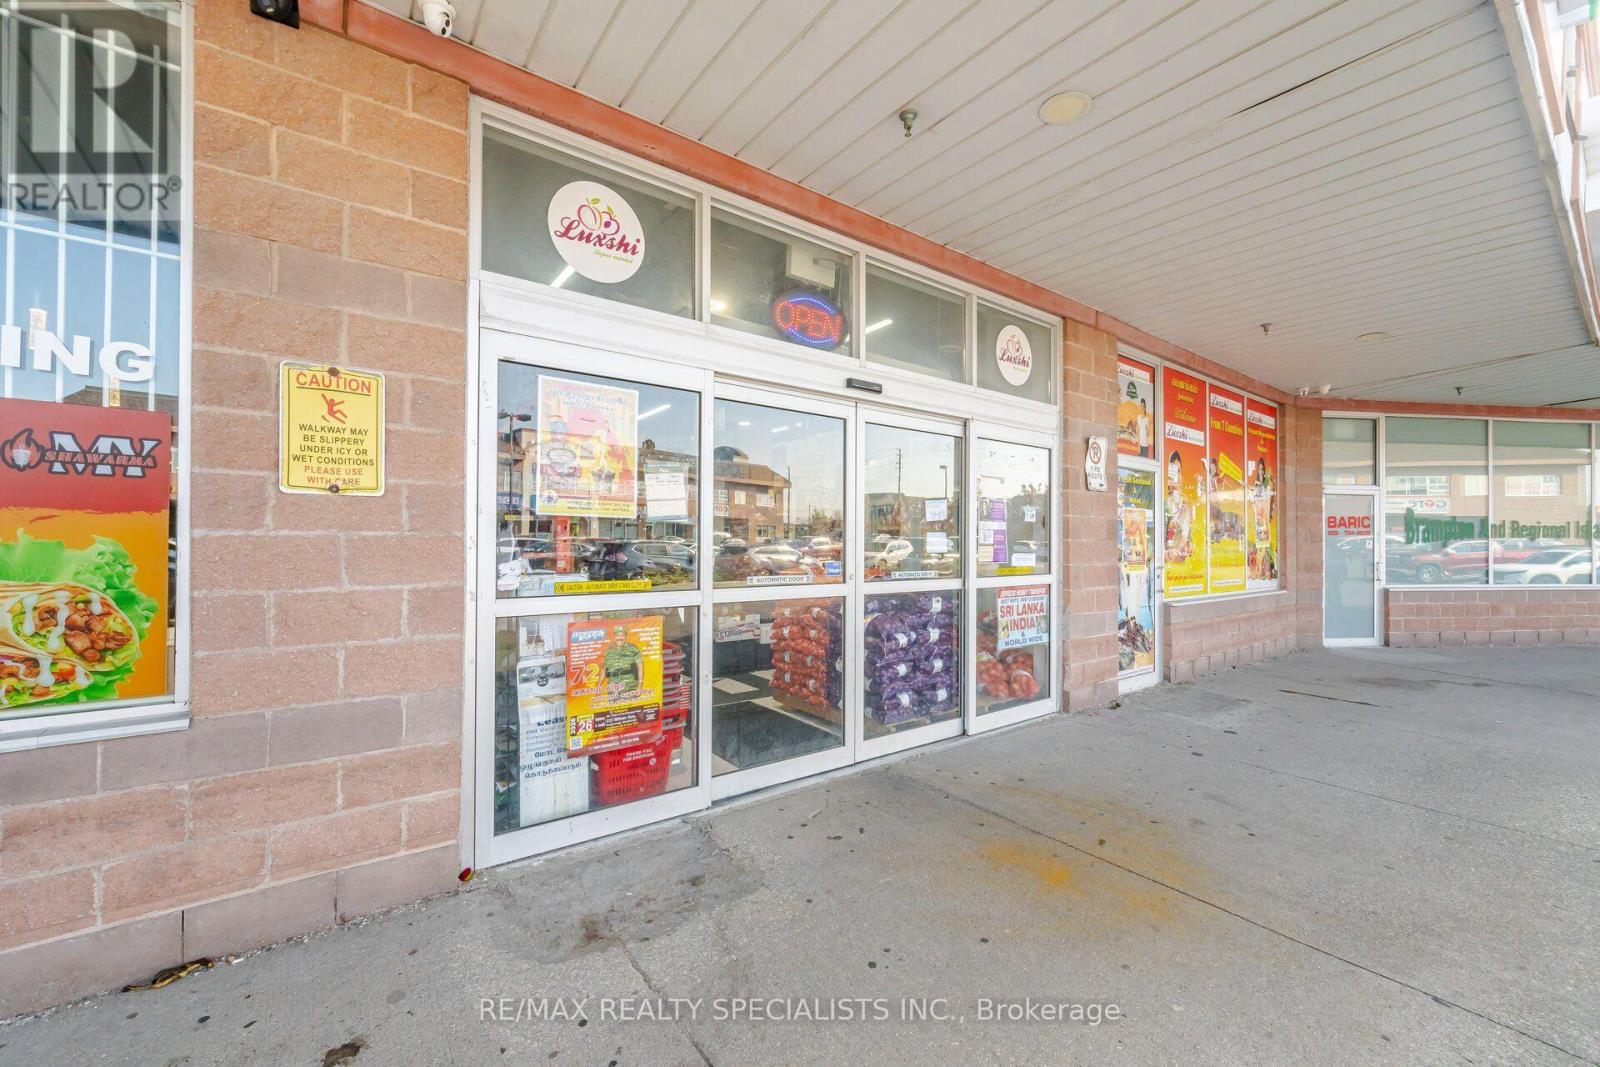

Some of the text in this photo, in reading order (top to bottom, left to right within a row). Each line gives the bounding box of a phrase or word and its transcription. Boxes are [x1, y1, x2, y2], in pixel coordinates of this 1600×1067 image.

[554, 216, 641, 256] Luxshi
[775, 300, 842, 343] OPEN
[0, 324, 156, 382] ING
[1000, 347, 1030, 368] Luxshi
[295, 371, 372, 393] CAUTION
[298, 423, 368, 436] WALKWAY MAY
[303, 434, 365, 446] BE SLIPPERY
[299, 444, 368, 456] UNDER ICY OR
[44, 451, 156, 467] SHAWARMA
[292, 454, 374, 466] WET CONDITIONS
[304, 465, 341, 475] PLEASE
[307, 476, 331, 485] WITH
[1327, 516, 1371, 528] BARIC
[1511, 520, 1571, 541] Regional
[1000, 601, 1045, 618] SRI LANKA
[1009, 616, 1036, 631] INDIA
[1004, 635, 1044, 648] WORLD WIDE
[570, 663, 600, 685] 72
[537, 716, 567, 726] Leas
[578, 720, 593, 733] 26
